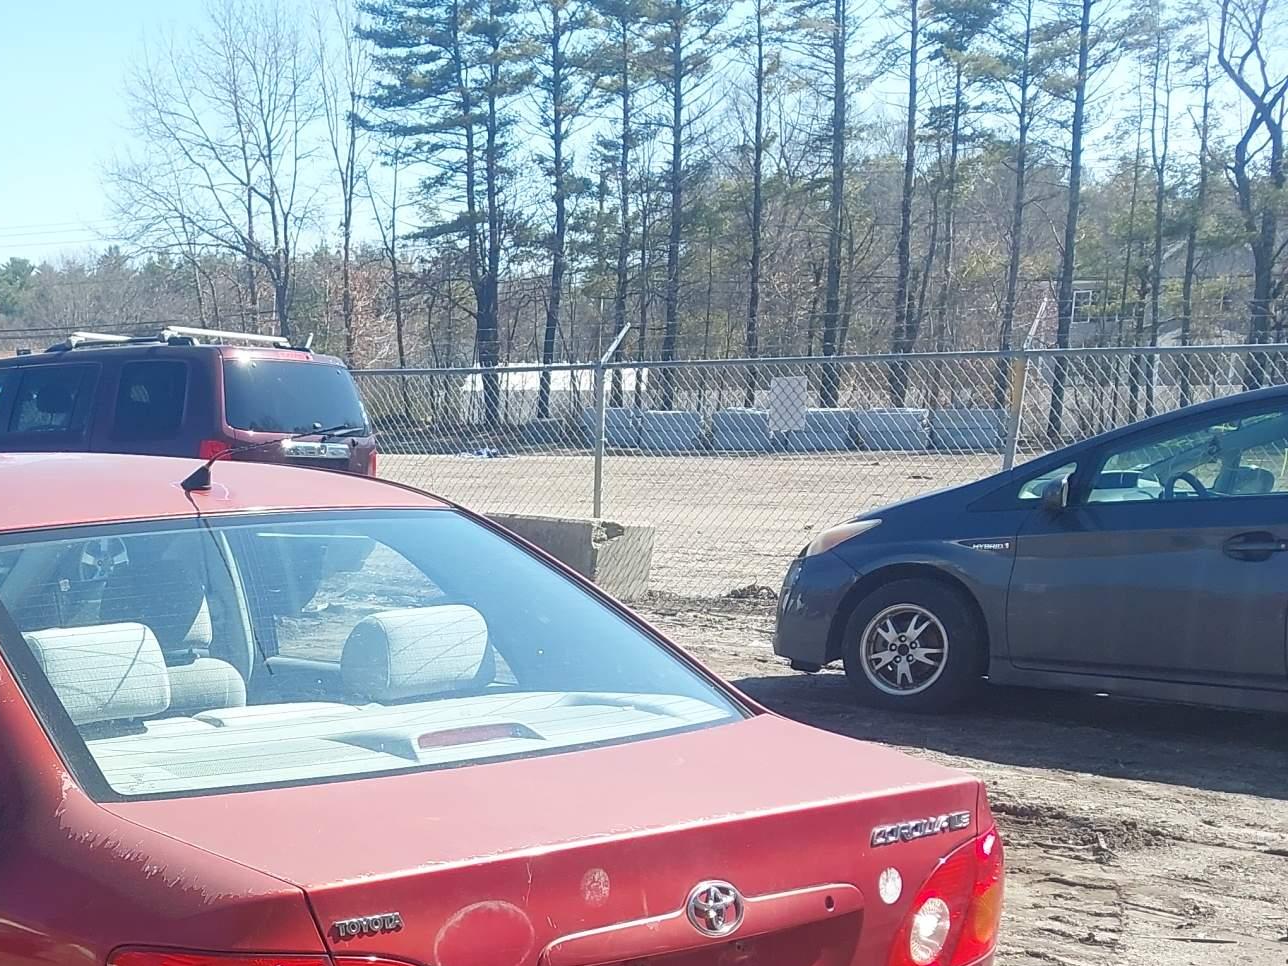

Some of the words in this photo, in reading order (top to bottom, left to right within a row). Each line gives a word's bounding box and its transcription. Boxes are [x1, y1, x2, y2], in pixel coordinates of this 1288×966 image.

[870, 814, 949, 847] COROLLA
[949, 811, 971, 832] LE
[332, 912, 403, 939] TOYOTA
